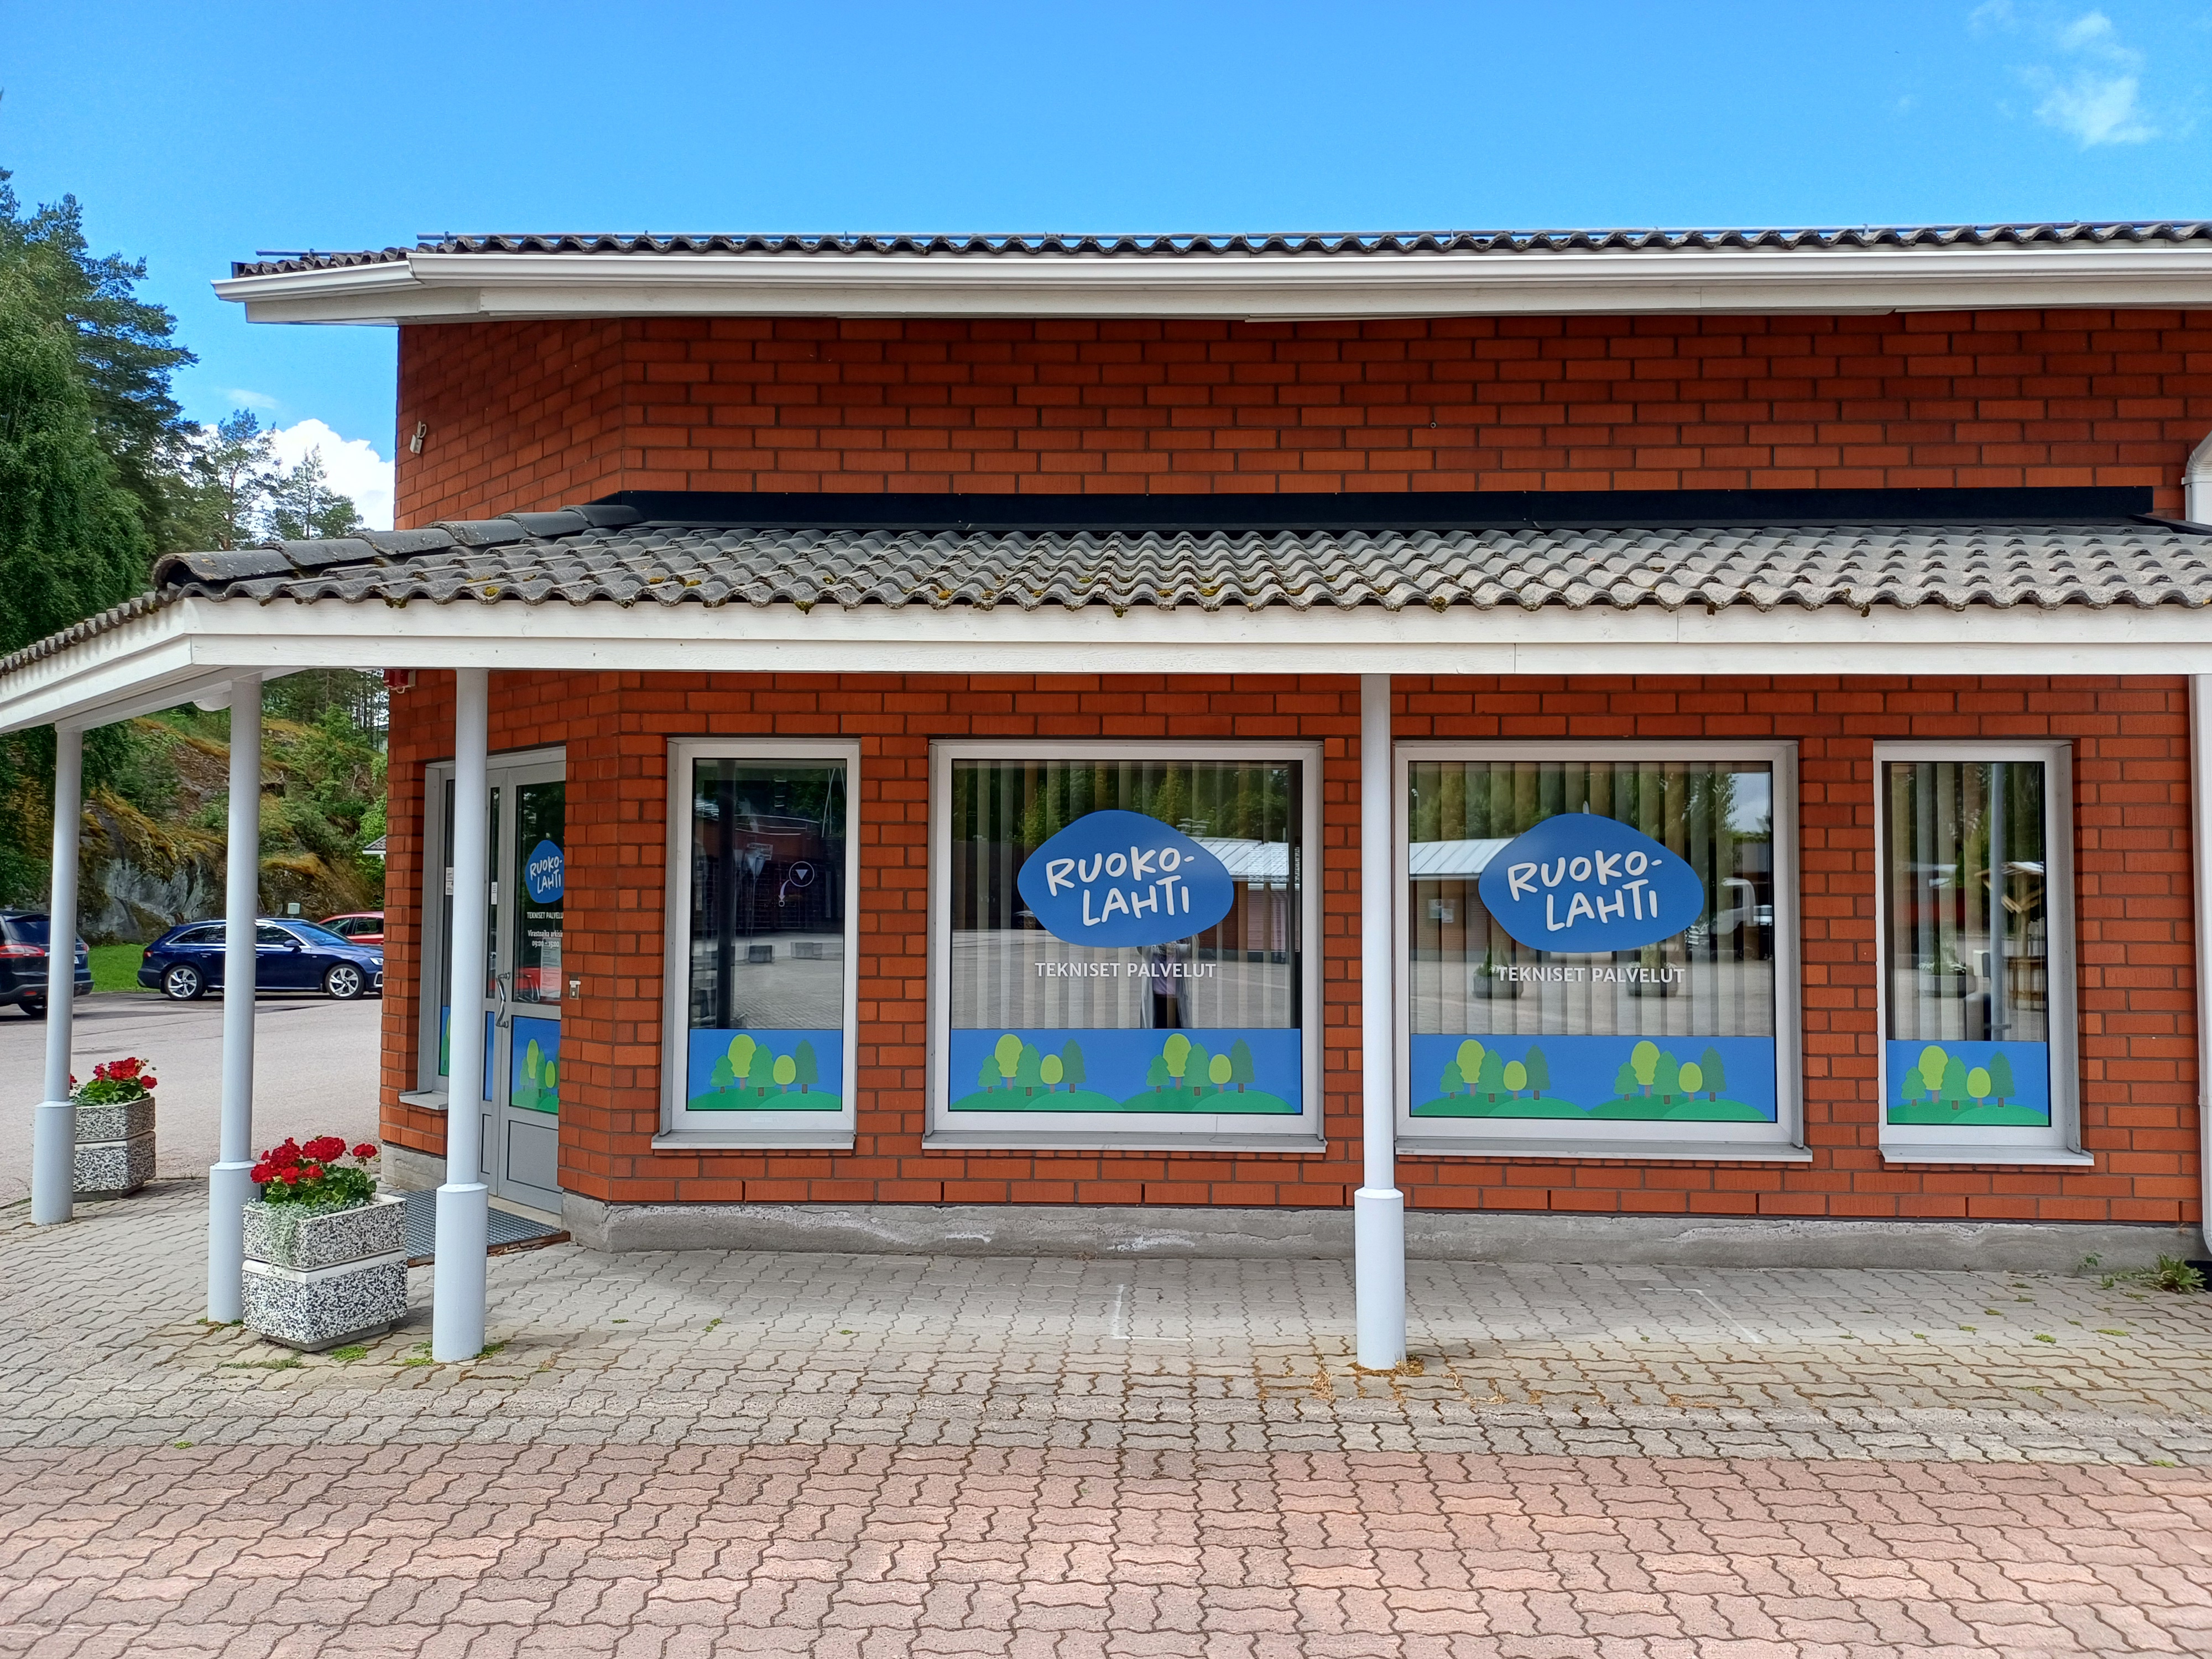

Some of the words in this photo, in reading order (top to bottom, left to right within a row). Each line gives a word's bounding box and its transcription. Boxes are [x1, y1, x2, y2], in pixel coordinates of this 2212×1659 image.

[530, 855, 562, 881] RUOKO-
[537, 869, 561, 894] LAHTI
[1045, 846, 1194, 897] RUOKO-
[1507, 849, 1662, 901] RUOKO-
[1082, 875, 1190, 927] LAHTI
[1546, 879, 1658, 932] LAHTI
[1035, 962, 1120, 977] TEKNISET
[1127, 963, 1217, 978] PALVELUT
[1497, 967, 1585, 982] TEKNISET
[1592, 968, 1686, 983] PALVELUT
